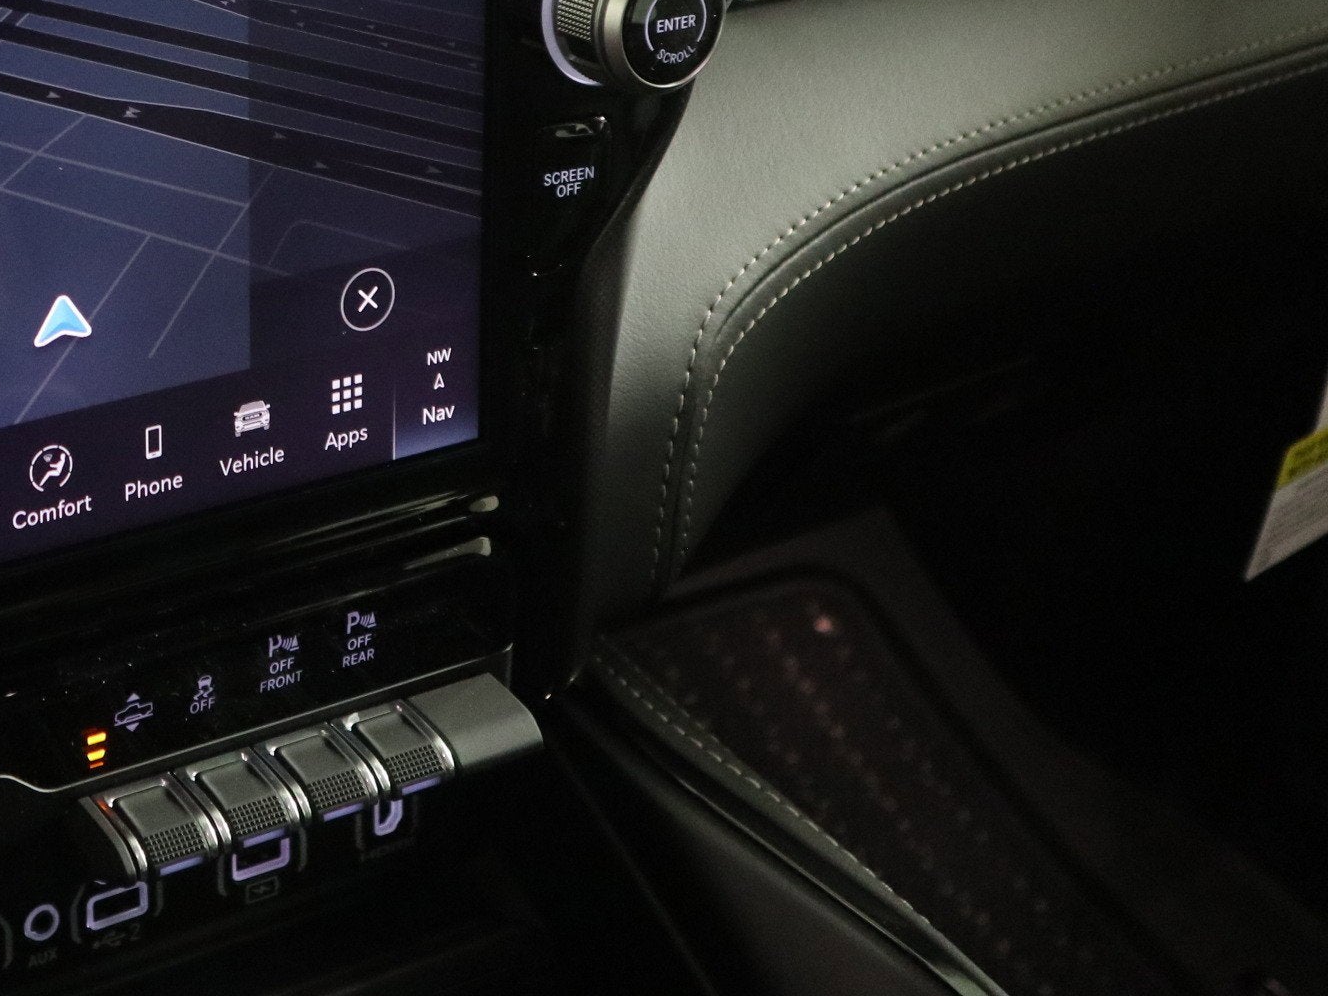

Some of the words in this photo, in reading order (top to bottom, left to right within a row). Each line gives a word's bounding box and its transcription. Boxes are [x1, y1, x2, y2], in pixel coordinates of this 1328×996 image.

[656, 14, 697, 34] ENTER
[656, 45, 697, 64] SCROLL
[543, 166, 595, 187] SCREEN
[556, 182, 582, 199] OFF
[426, 348, 452, 366] NW
[422, 406, 455, 425] Nav
[324, 428, 369, 451] Apps
[220, 447, 285, 477] Vehicle
[124, 475, 184, 502] Phone
[12, 495, 93, 530] Comfort
[347, 633, 373, 652] OFF
[269, 657, 296, 676] OFF
[341, 649, 376, 668] REAR
[259, 669, 304, 694] FRONT
[189, 697, 217, 715] OFF
